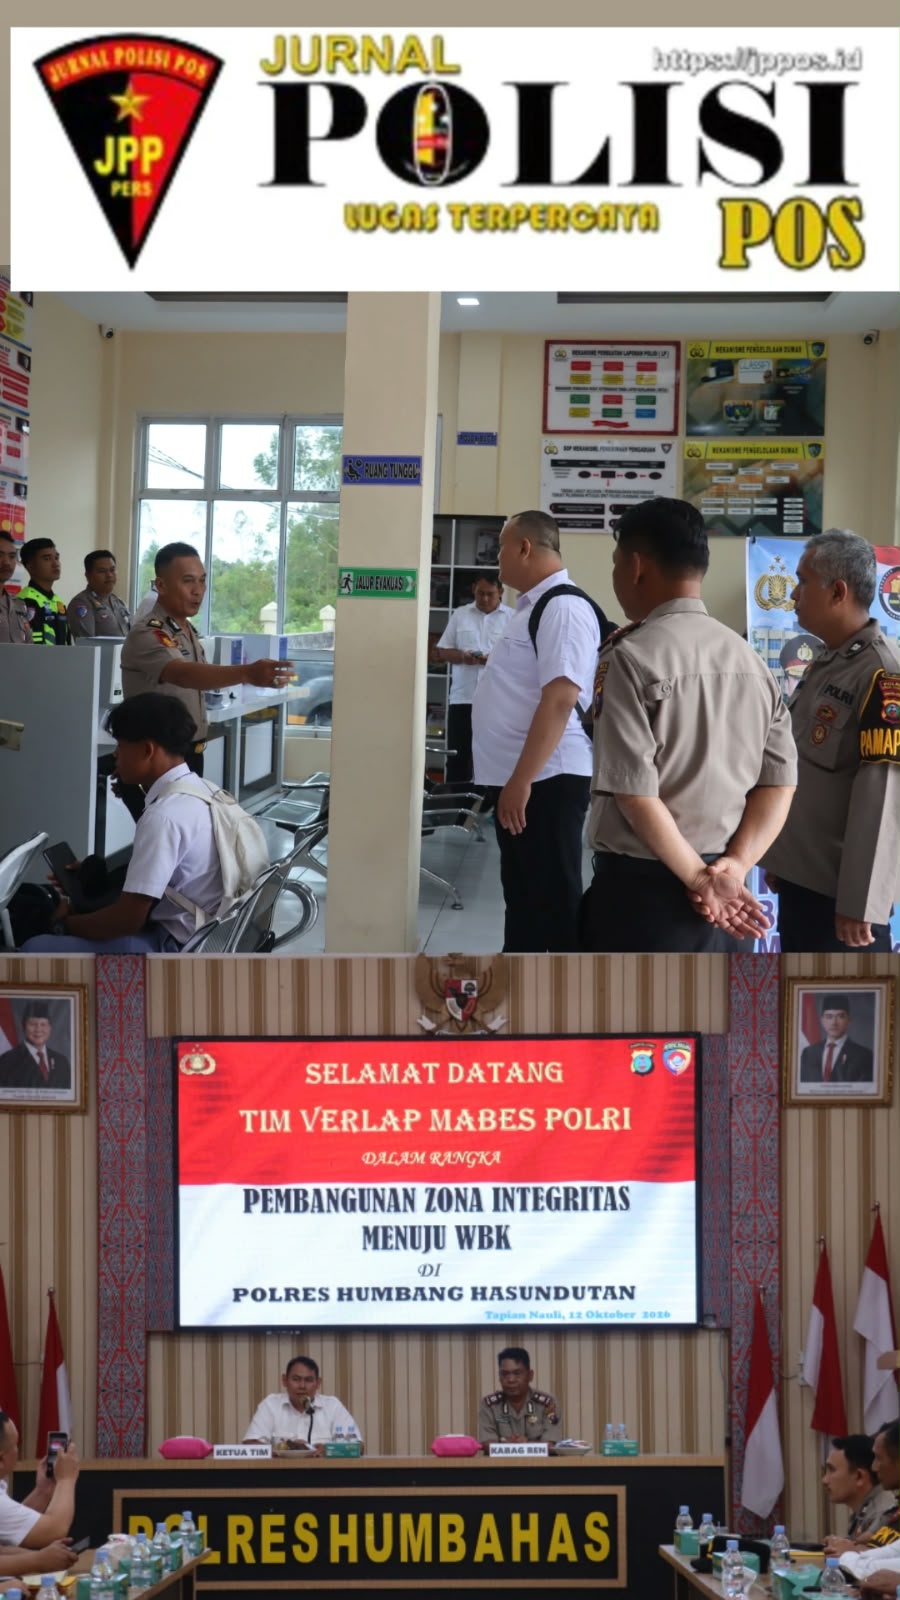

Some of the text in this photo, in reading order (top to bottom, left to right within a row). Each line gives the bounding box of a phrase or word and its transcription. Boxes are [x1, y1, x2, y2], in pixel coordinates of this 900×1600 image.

[364, 462, 420, 479] RUANG TUNGGU
[824, 684, 854, 705] POLRI
[305, 1061, 563, 1085] SELAMAT DATANG
[239, 1106, 632, 1133] TIM VERLAP MABES POLRI
[361, 1150, 502, 1169] DALAM RANGKA
[243, 1186, 630, 1214] PEMBANGUNAN ZONA INTEGRITAS
[362, 1225, 511, 1254] MENUJU WBK
[417, 1263, 441, 1278] DI
[233, 1285, 636, 1302] POLRES HUMBANG HASUNDUTAN
[485, 1310, 525, 1322] Tapian
[529, 1310, 565, 1321] Nauli,
[586, 1309, 637, 1319] Oktober
[216, 1448, 269, 1457] KETUA TIM
[490, 1447, 525, 1455] KABAG
